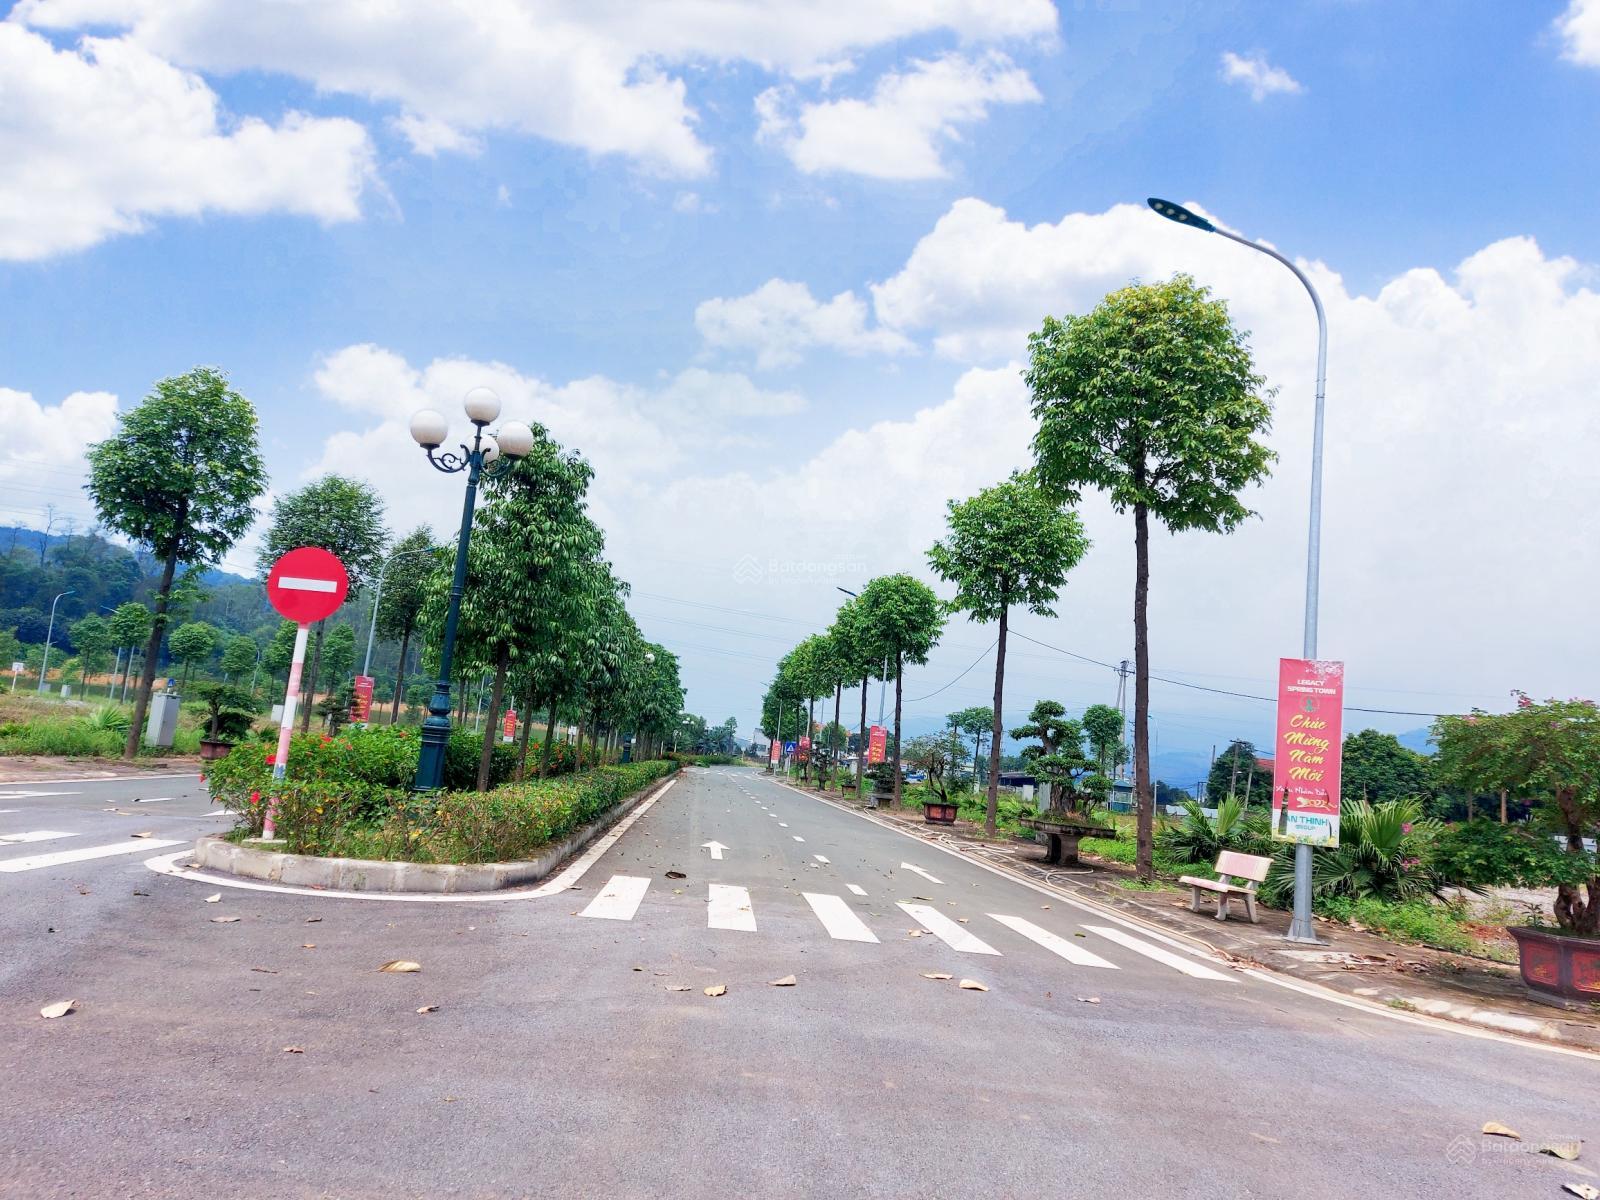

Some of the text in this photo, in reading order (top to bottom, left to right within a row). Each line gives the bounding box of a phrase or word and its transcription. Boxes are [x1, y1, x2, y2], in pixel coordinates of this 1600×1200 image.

[1314, 687, 1336, 695] TOWN
[1290, 714, 1328, 730] Chúc
[1283, 731, 1330, 754] Mừng
[1289, 749, 1324, 764] Năm
[1288, 766, 1324, 782] Mới
